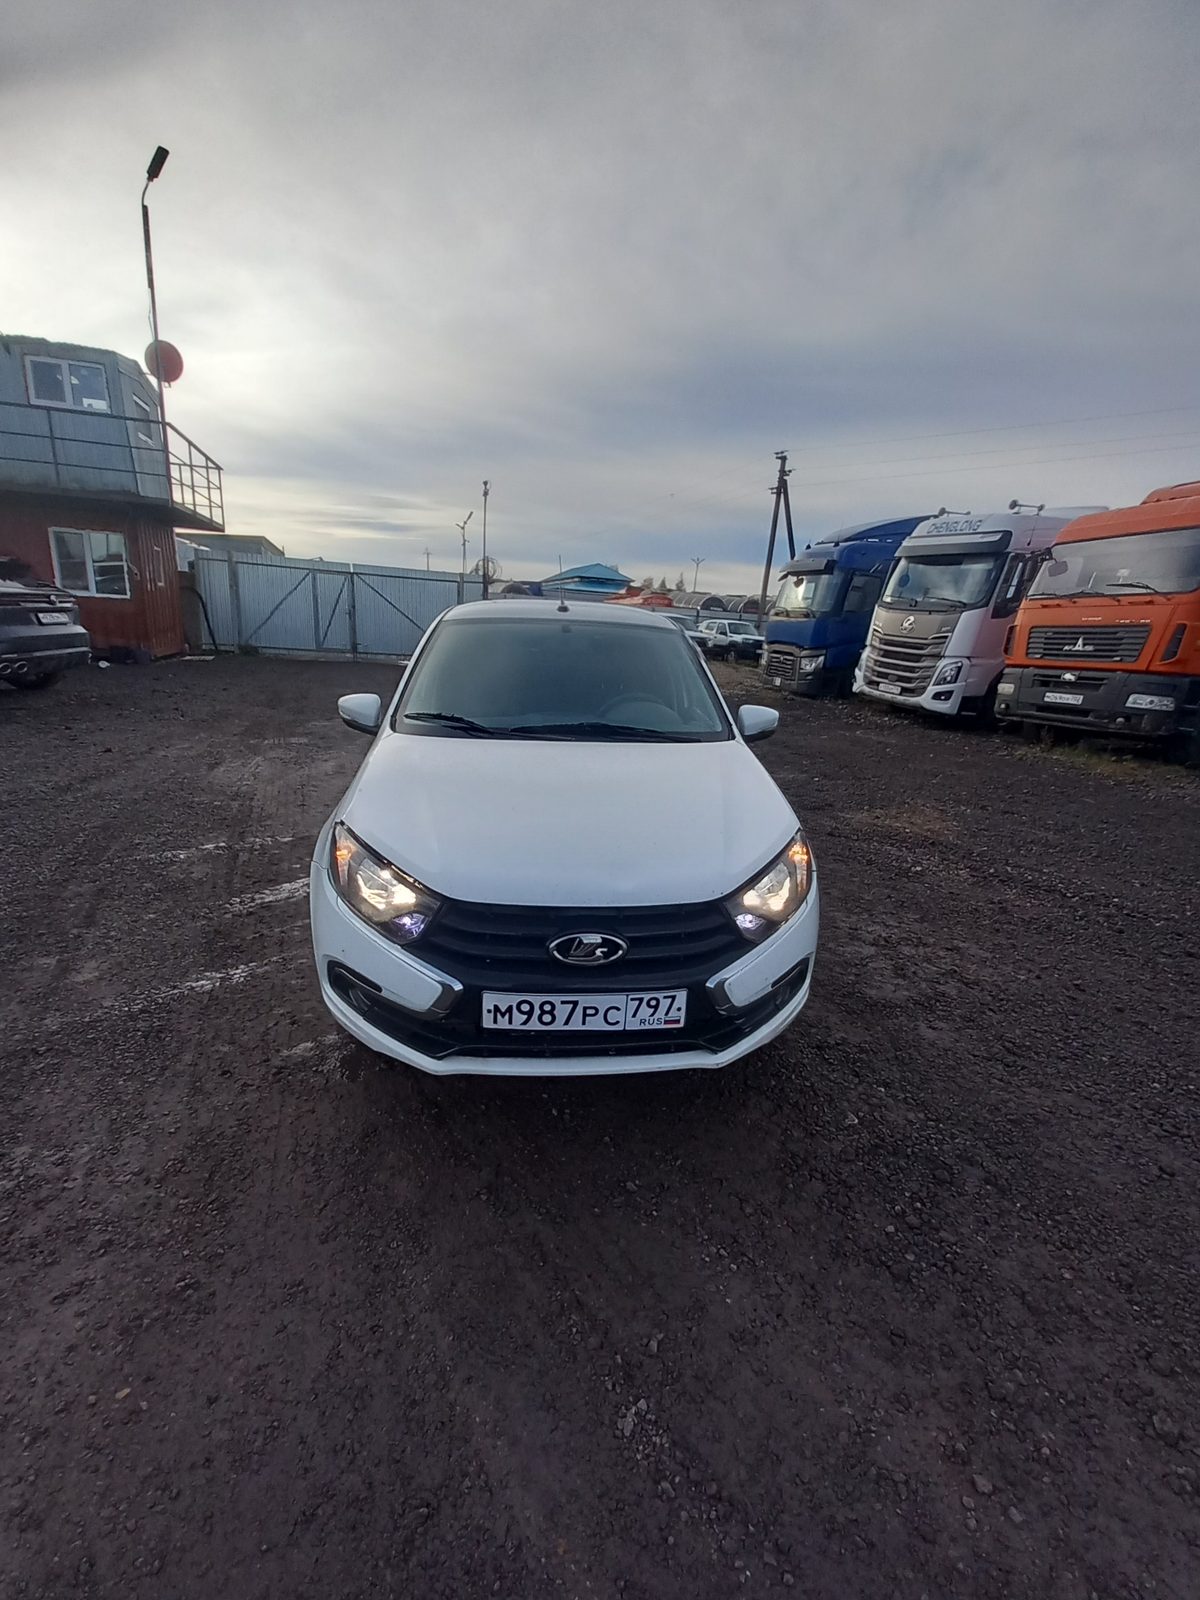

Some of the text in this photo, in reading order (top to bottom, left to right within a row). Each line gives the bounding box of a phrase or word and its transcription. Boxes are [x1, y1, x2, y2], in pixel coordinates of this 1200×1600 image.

[492, 995, 677, 1027] М987РС 797
[639, 1016, 663, 1027] RUS
